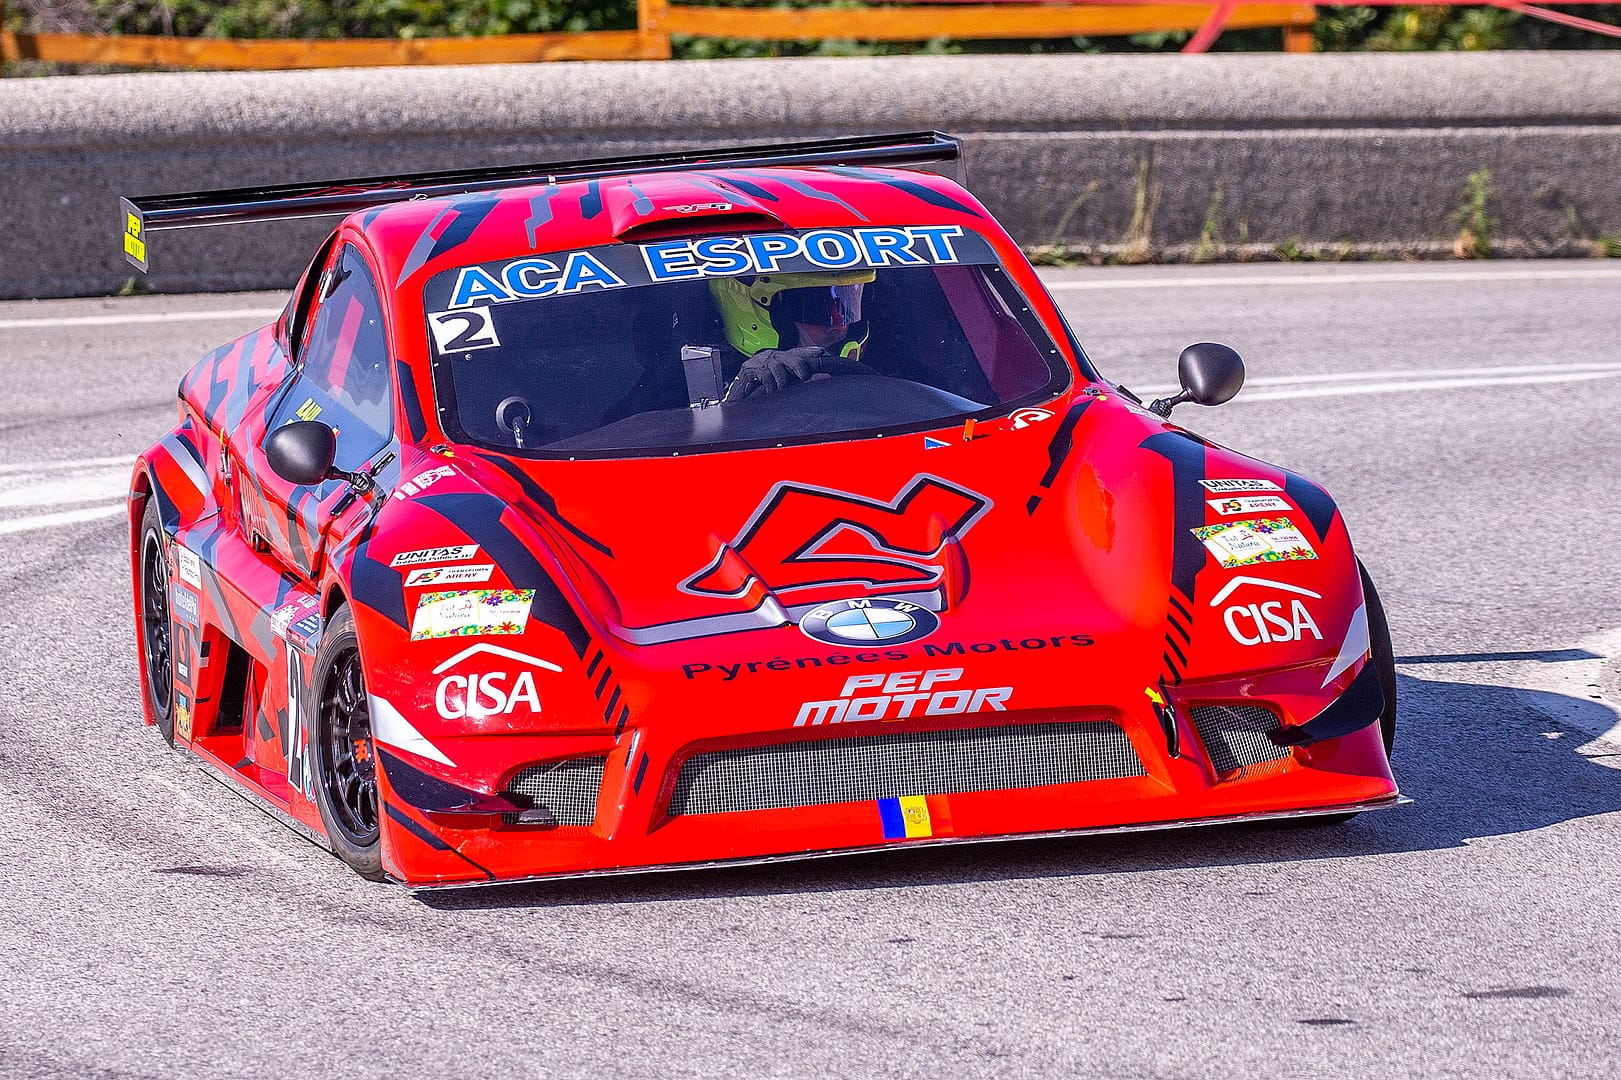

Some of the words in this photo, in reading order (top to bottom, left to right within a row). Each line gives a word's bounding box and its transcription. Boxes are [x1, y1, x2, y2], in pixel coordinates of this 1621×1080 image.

[448, 251, 628, 309] ACA
[640, 225, 963, 282] ESPORT
[437, 312, 494, 351] 2
[1203, 480, 1263, 488] UNITAS
[397, 547, 463, 560] UNITAS
[814, 599, 920, 619] BMW
[1223, 600, 1323, 646] CISA
[682, 650, 908, 681] Pyrénées
[923, 632, 1095, 657] Motors
[435, 671, 542, 720] CISA
[840, 668, 964, 698] PEP
[793, 686, 1013, 727] MOTOR
